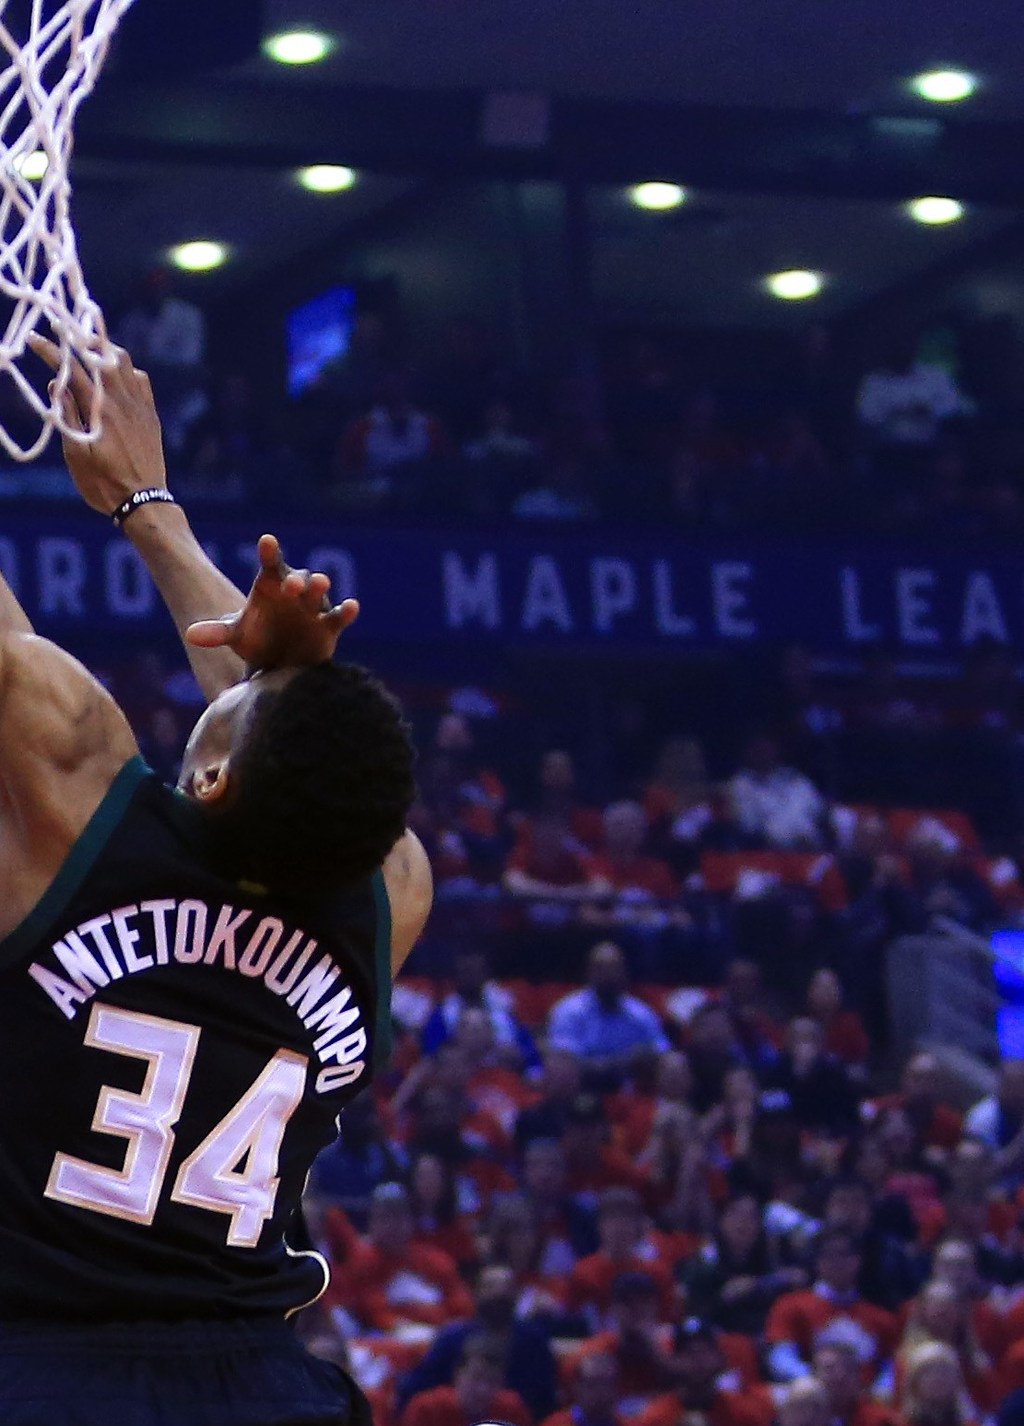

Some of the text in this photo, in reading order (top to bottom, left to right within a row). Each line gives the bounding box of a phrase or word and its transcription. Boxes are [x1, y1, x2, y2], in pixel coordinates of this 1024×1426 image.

[441, 550, 758, 638] MAPLE
[838, 565, 1010, 646] LEA
[27, 898, 368, 1095] ANTETOKOUNMPO
[43, 1000, 310, 1249] 34
